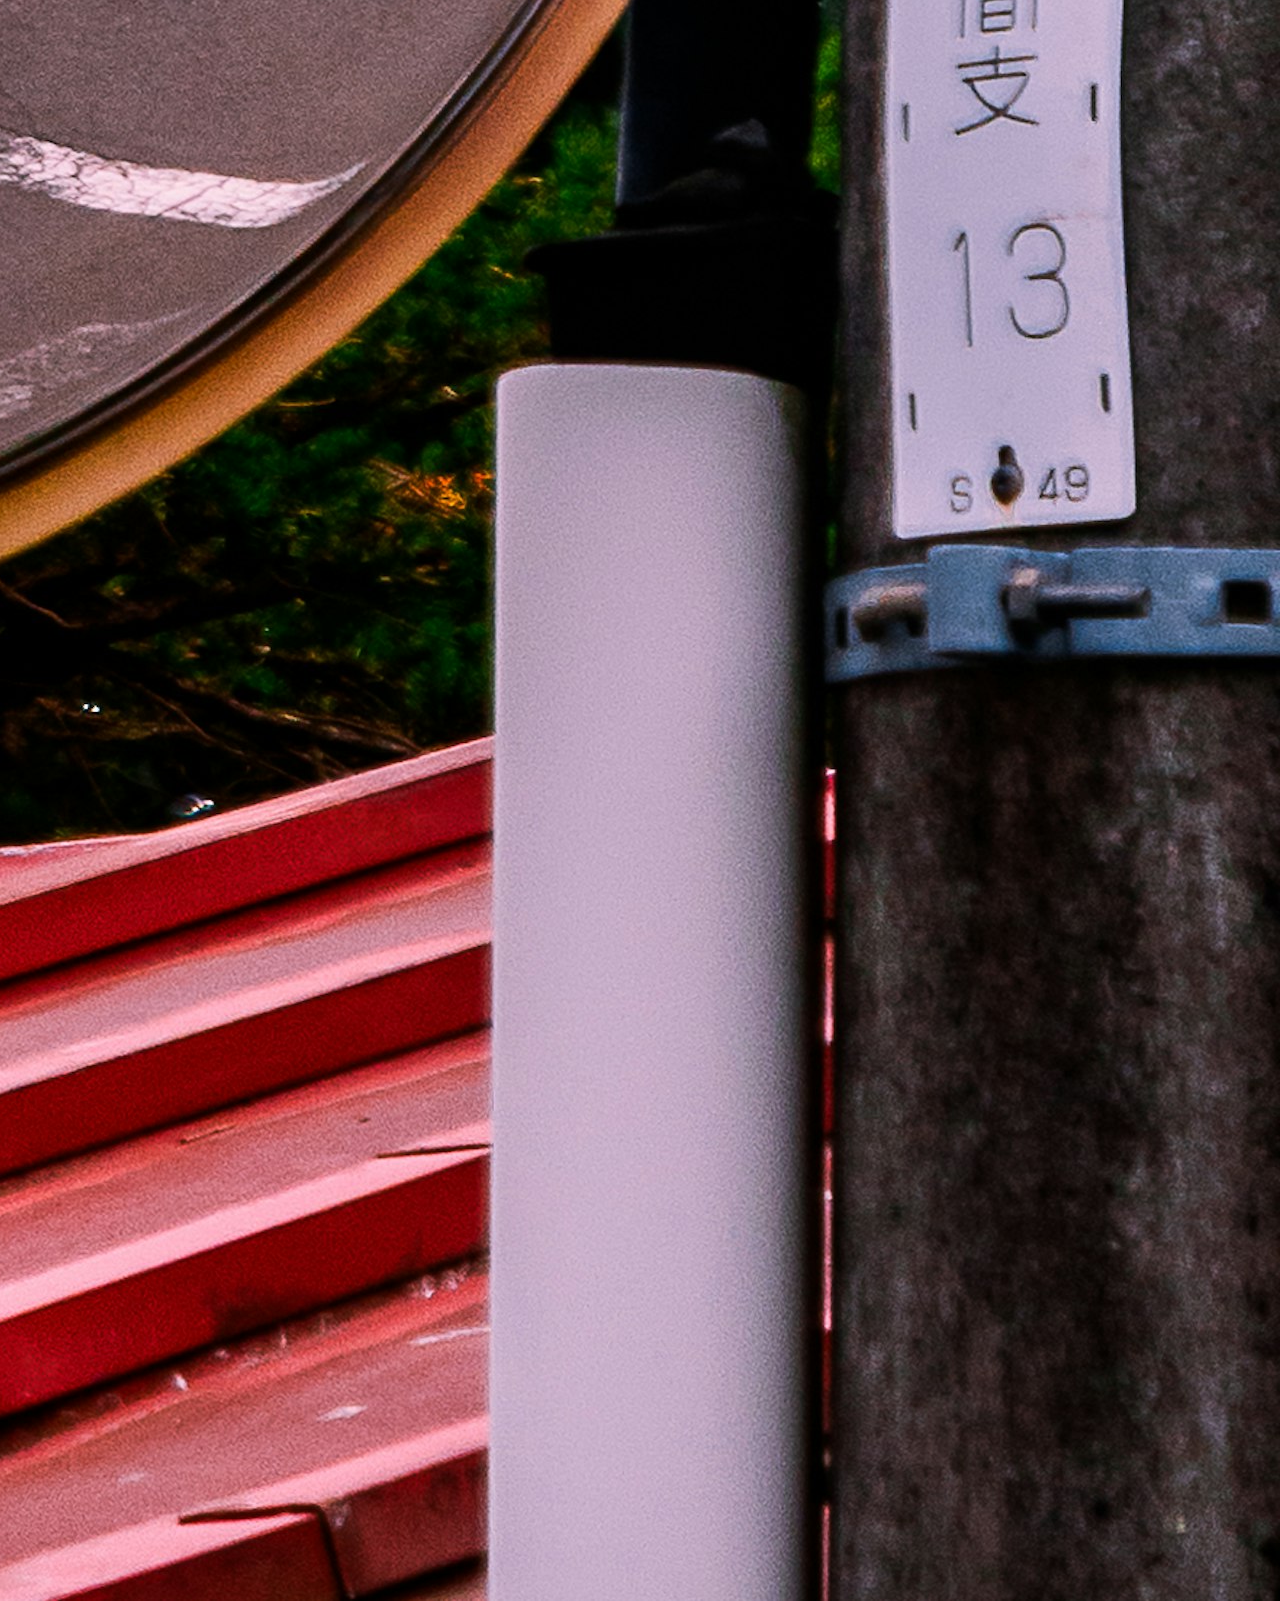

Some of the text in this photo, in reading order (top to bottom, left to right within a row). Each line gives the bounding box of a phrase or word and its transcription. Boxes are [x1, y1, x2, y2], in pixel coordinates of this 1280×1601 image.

[951, 217, 1071, 348] 13
[949, 463, 1091, 515] S 49
